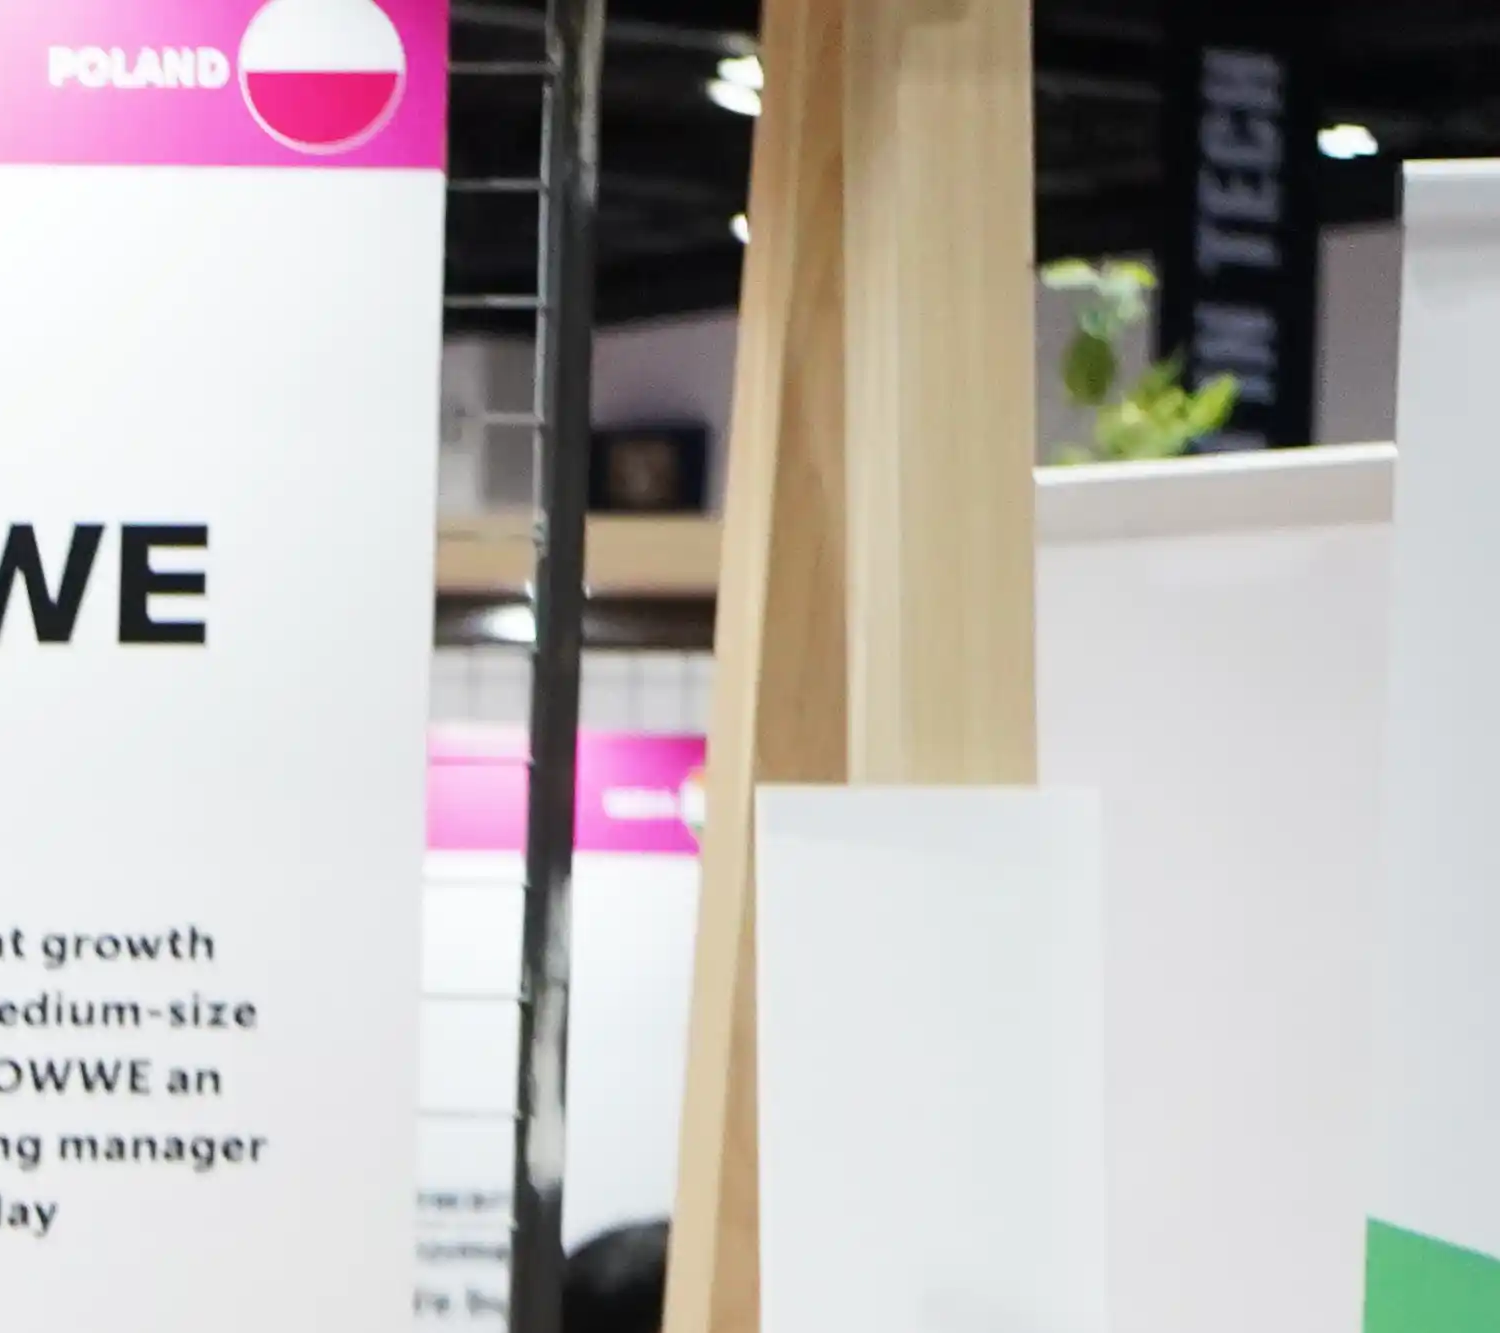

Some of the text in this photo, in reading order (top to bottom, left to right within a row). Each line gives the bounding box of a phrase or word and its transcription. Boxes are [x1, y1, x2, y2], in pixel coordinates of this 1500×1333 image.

[46, 46, 230, 90] POLAND
[41, 925, 214, 969] growth
[166, 1069, 221, 1095] an
[59, 1135, 265, 1173] manager
